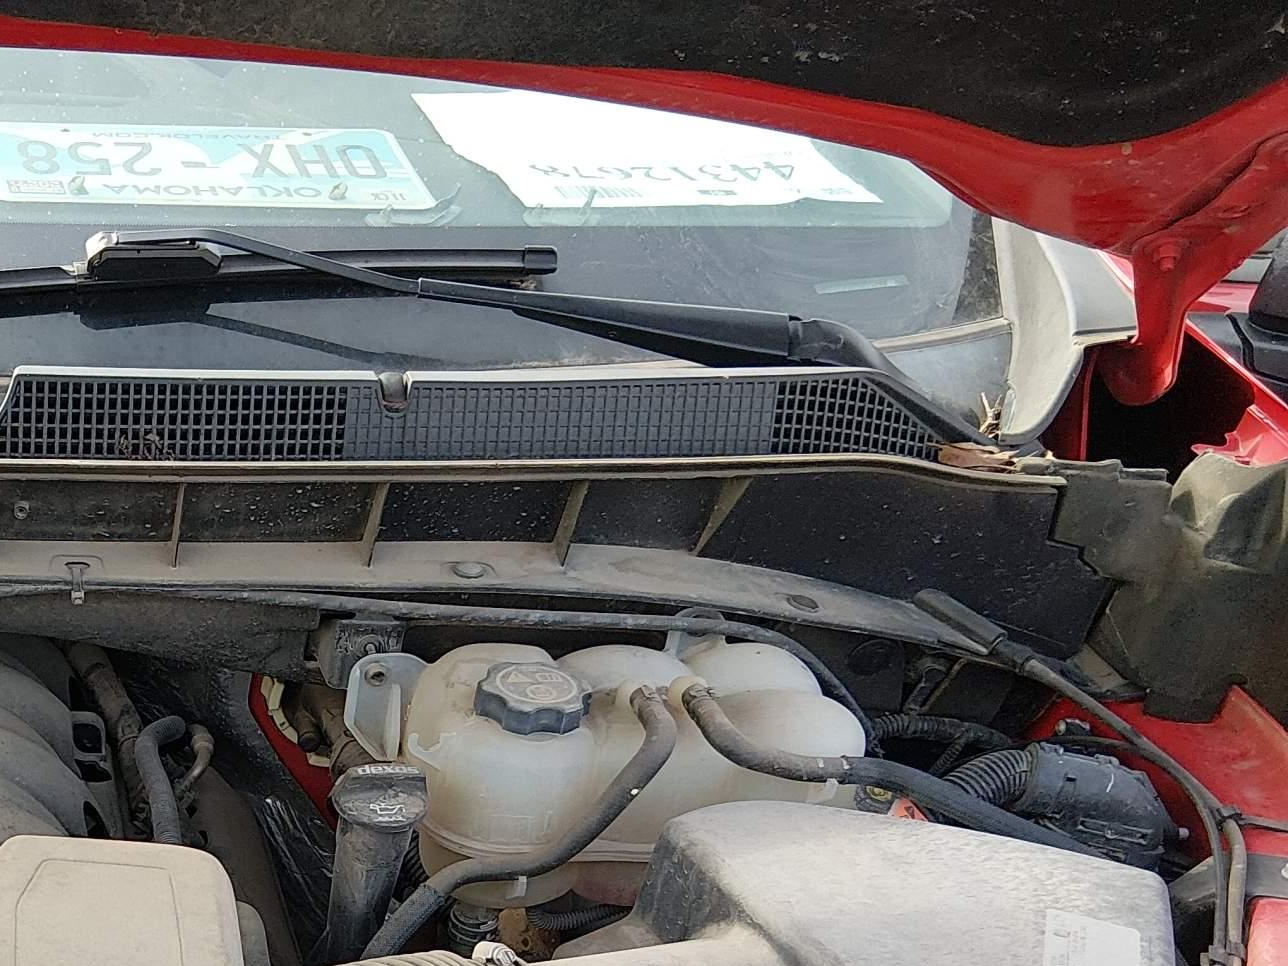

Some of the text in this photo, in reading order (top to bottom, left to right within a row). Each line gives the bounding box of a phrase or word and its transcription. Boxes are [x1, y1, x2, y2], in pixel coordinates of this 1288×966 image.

[17, 140, 162, 176] 258
[102, 183, 322, 198] OKLAHOMA
[357, 764, 420, 775] dexos
